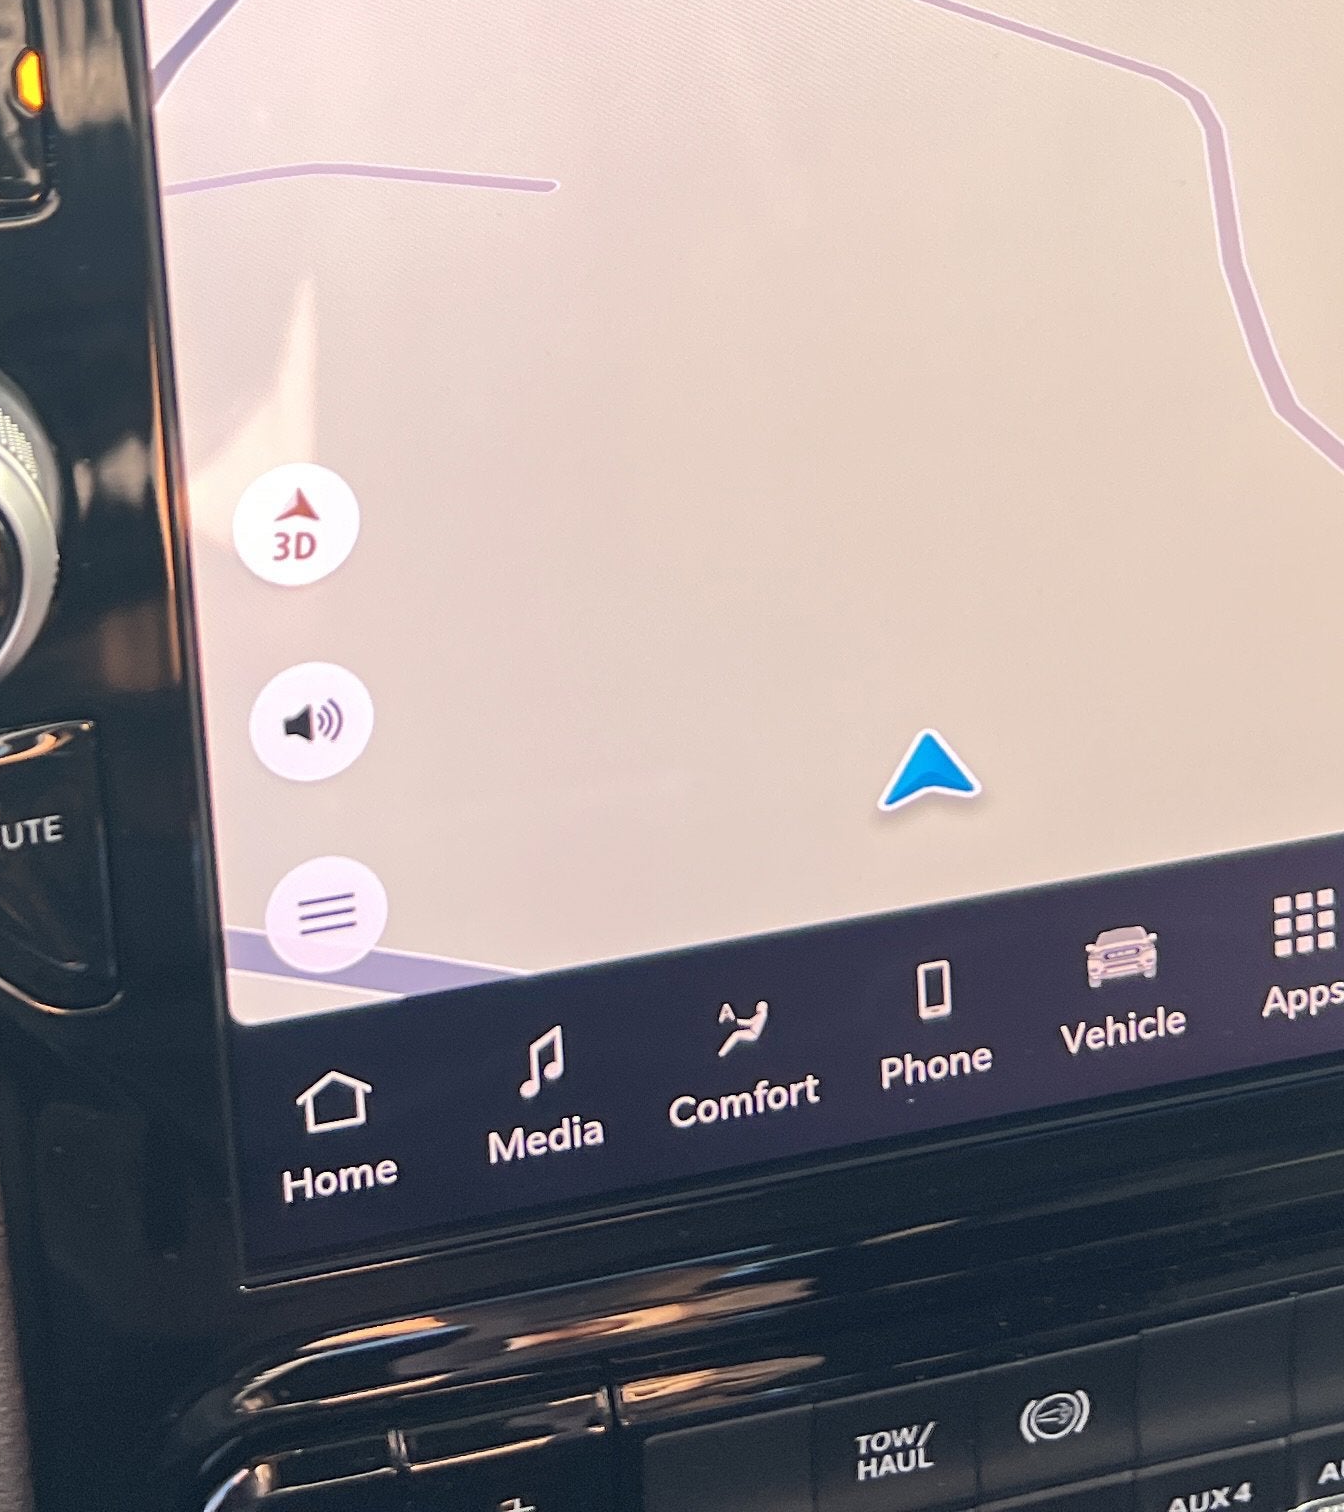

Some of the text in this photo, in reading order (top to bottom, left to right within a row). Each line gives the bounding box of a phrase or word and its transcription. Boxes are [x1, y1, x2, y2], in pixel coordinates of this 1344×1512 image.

[273, 531, 317, 561] 3D
[1060, 1005, 1187, 1055] Vehicle
[880, 1044, 994, 1090] Phone
[668, 1074, 821, 1129] Comfort
[487, 1115, 605, 1166] Media
[282, 1156, 399, 1204] Home
[856, 1421, 937, 1456] TOW/
[857, 1448, 935, 1481] HAUL
[1168, 1488, 1230, 1512] AUX
